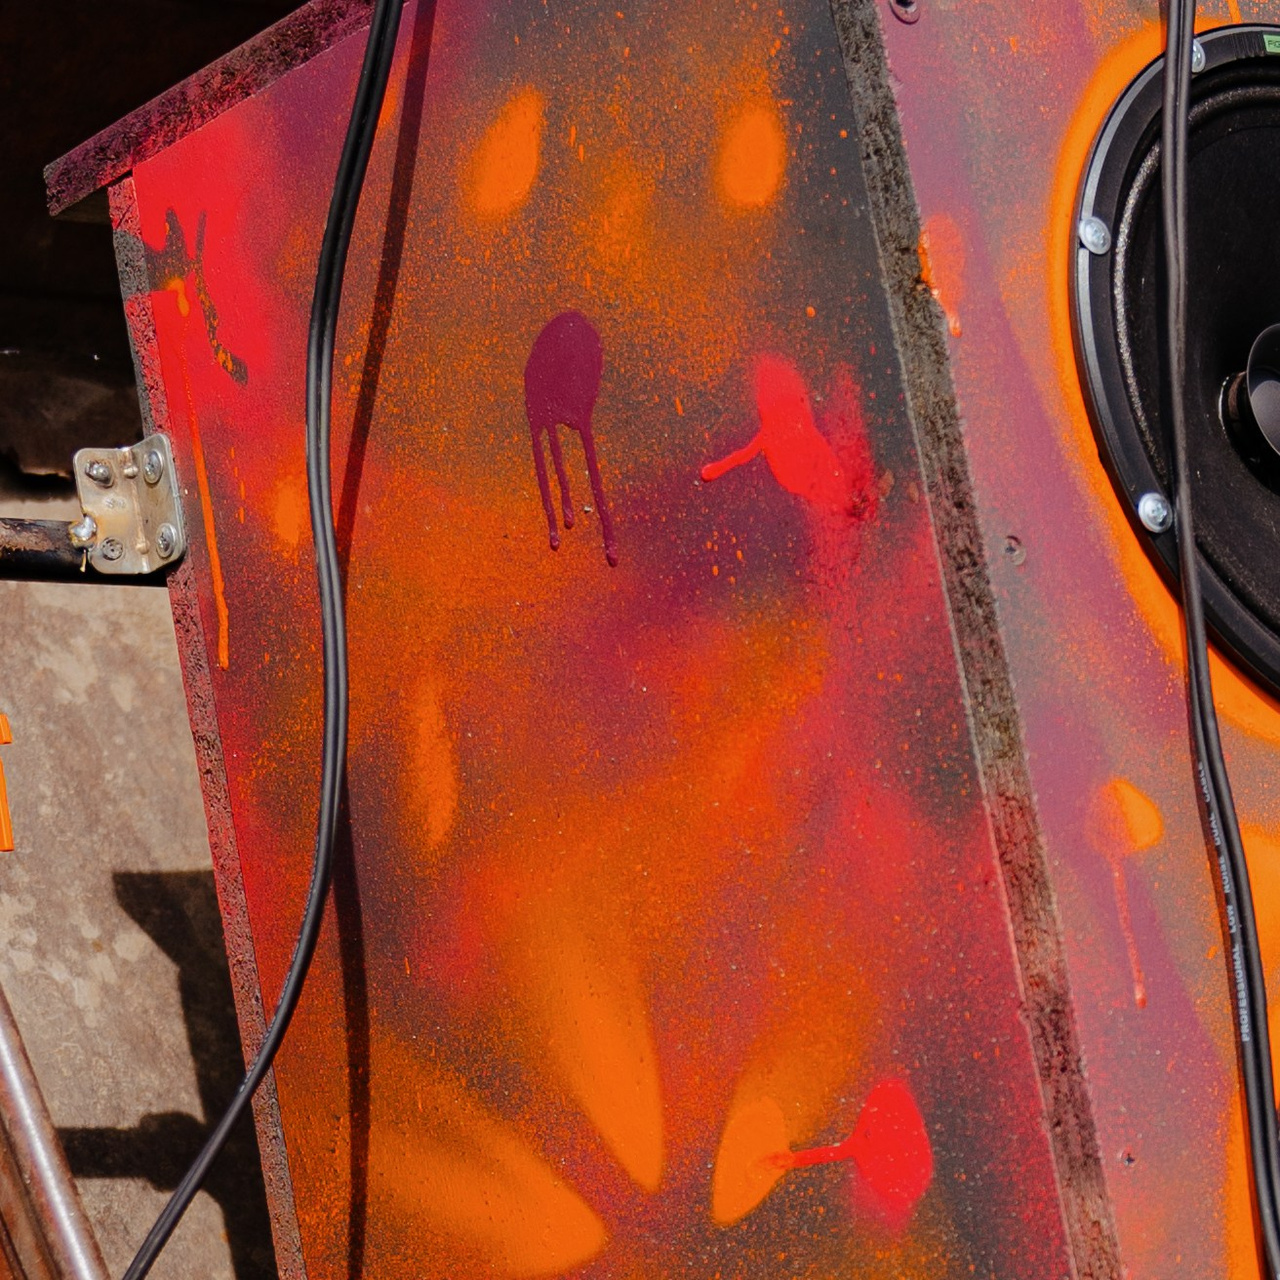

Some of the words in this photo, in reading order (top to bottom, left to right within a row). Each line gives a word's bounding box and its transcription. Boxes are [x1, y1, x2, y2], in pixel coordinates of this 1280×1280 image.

[1207, 812, 1222, 847] DUAL
[1217, 856, 1231, 894] NOISE
[1227, 904, 1238, 934] LOW
[1233, 943, 1250, 1043] PROFESSIONAL
